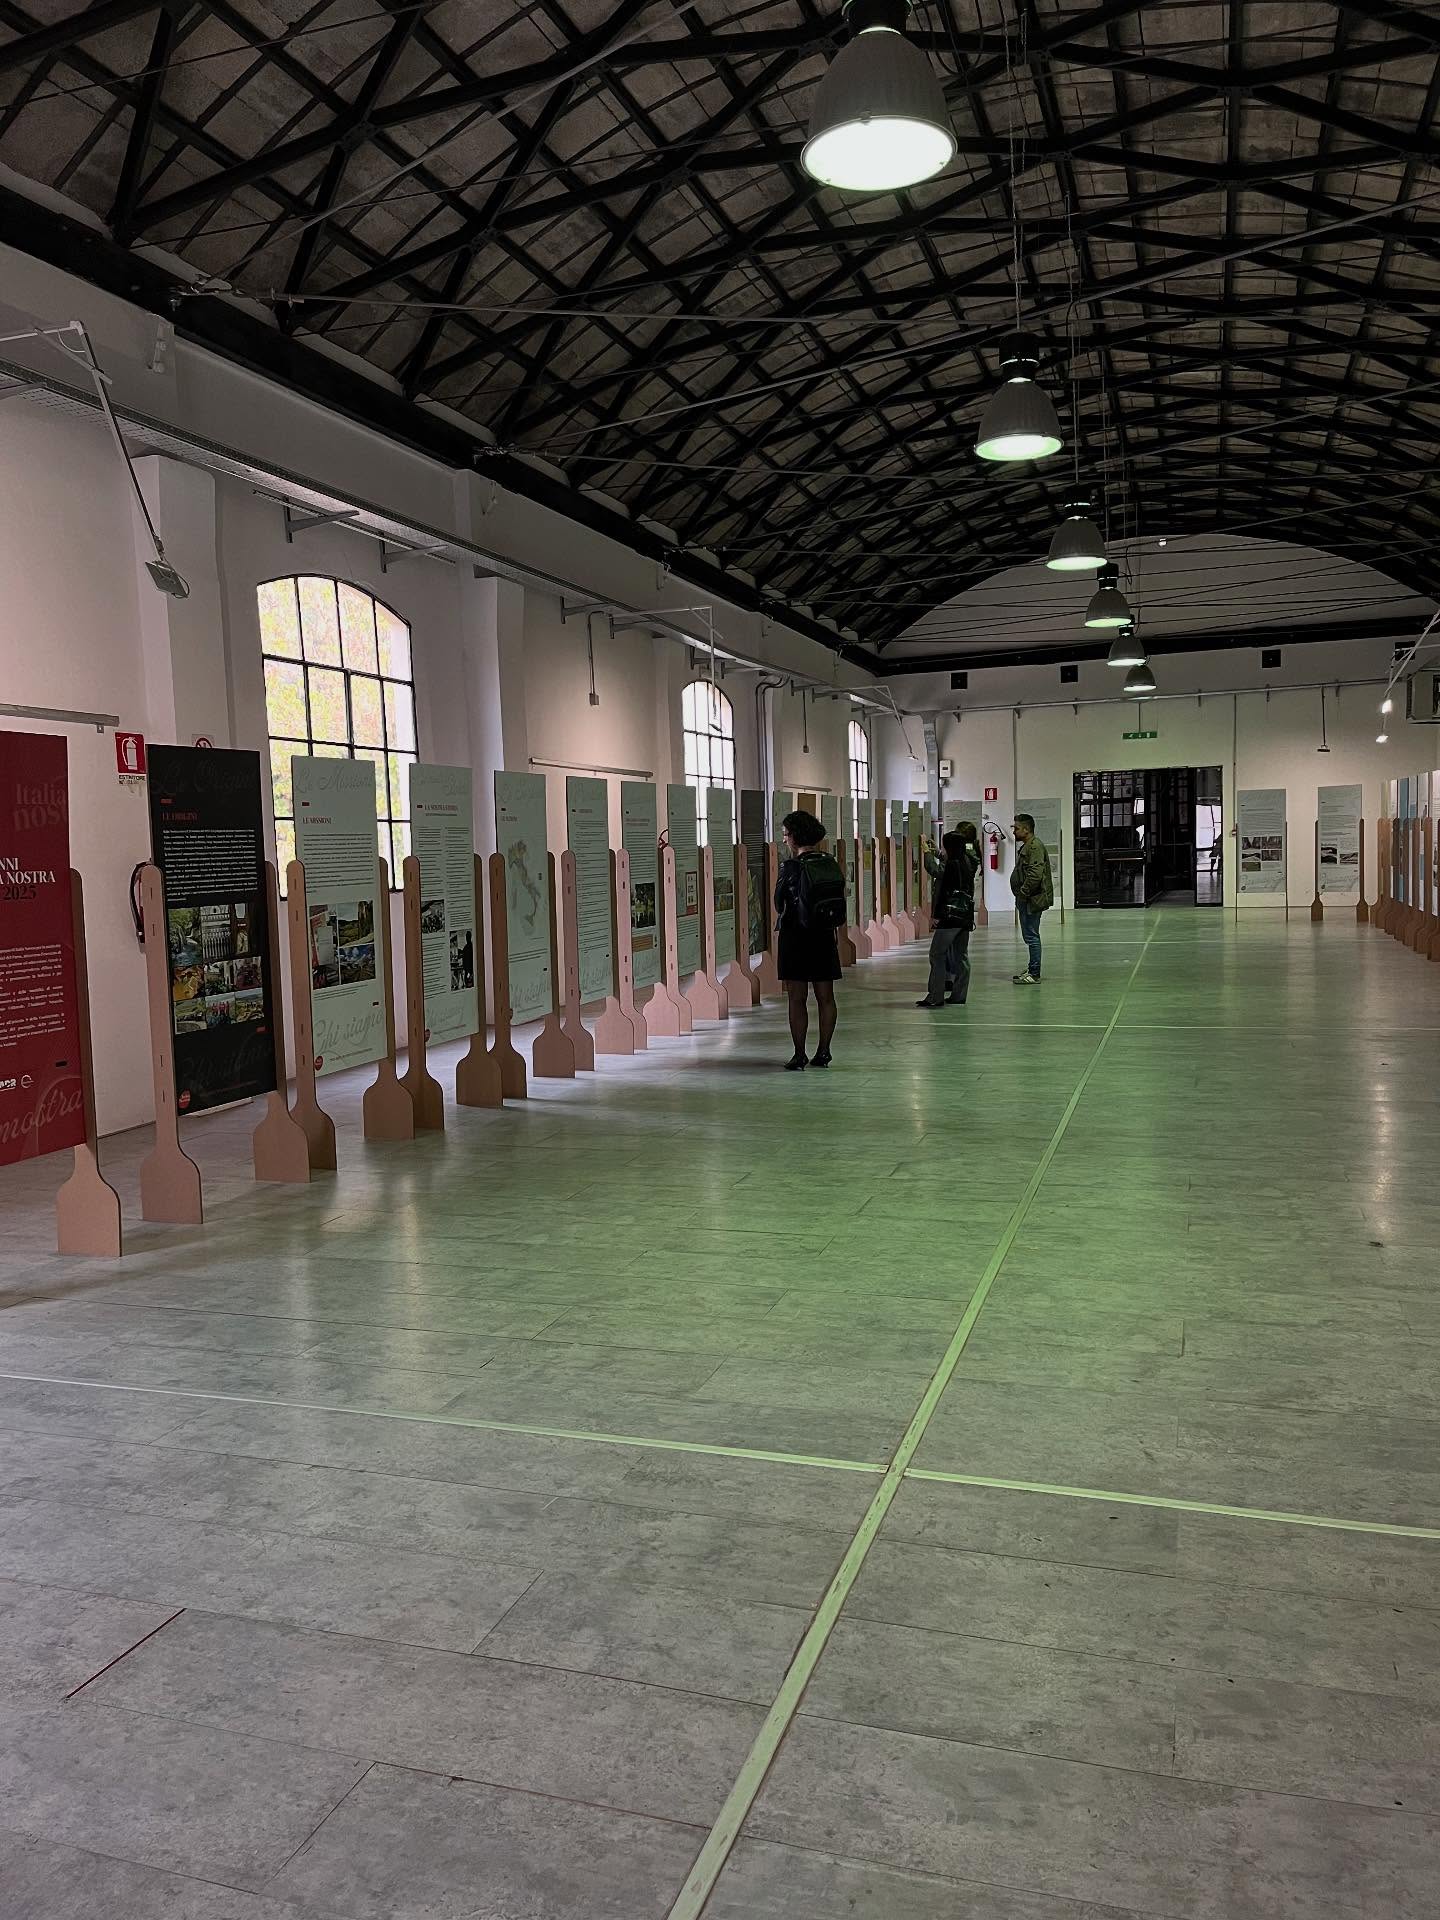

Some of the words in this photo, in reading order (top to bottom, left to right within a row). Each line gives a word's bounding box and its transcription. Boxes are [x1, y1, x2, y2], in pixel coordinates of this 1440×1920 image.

[16, 783, 66, 805] Italia
[6, 870, 56, 885] NOSTRA
[3, 885, 37, 900] 2025
